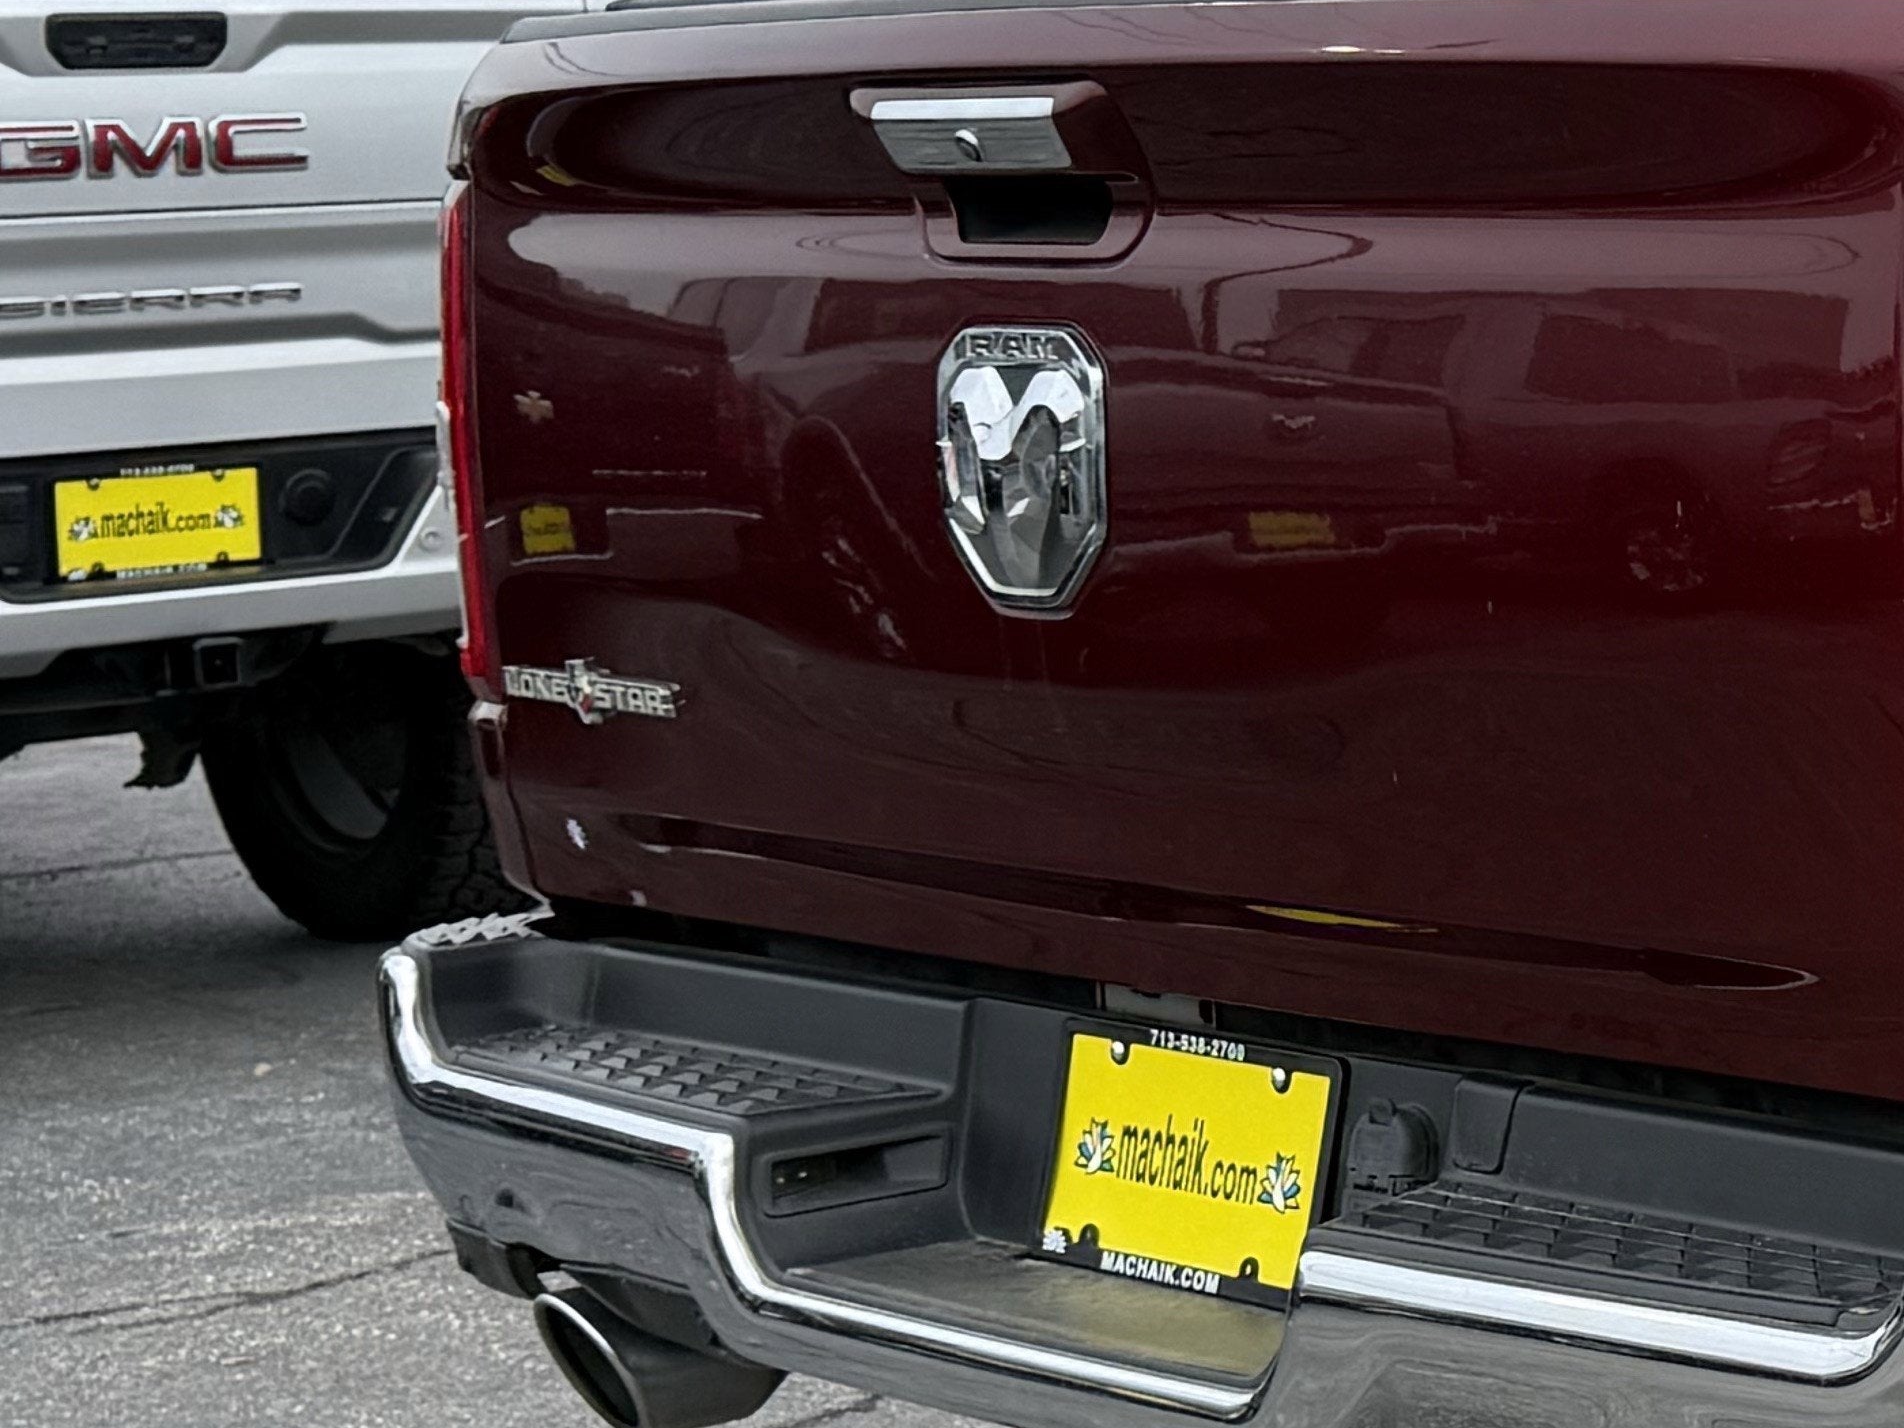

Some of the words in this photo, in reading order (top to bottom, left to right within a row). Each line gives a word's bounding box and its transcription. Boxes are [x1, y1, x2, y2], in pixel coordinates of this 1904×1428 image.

[0, 111, 309, 184] GMC
[966, 333, 1060, 361] RAM
[1114, 1113, 1258, 1206] machaik.com
[1100, 1250, 1221, 1295] MACHAIK.COM
